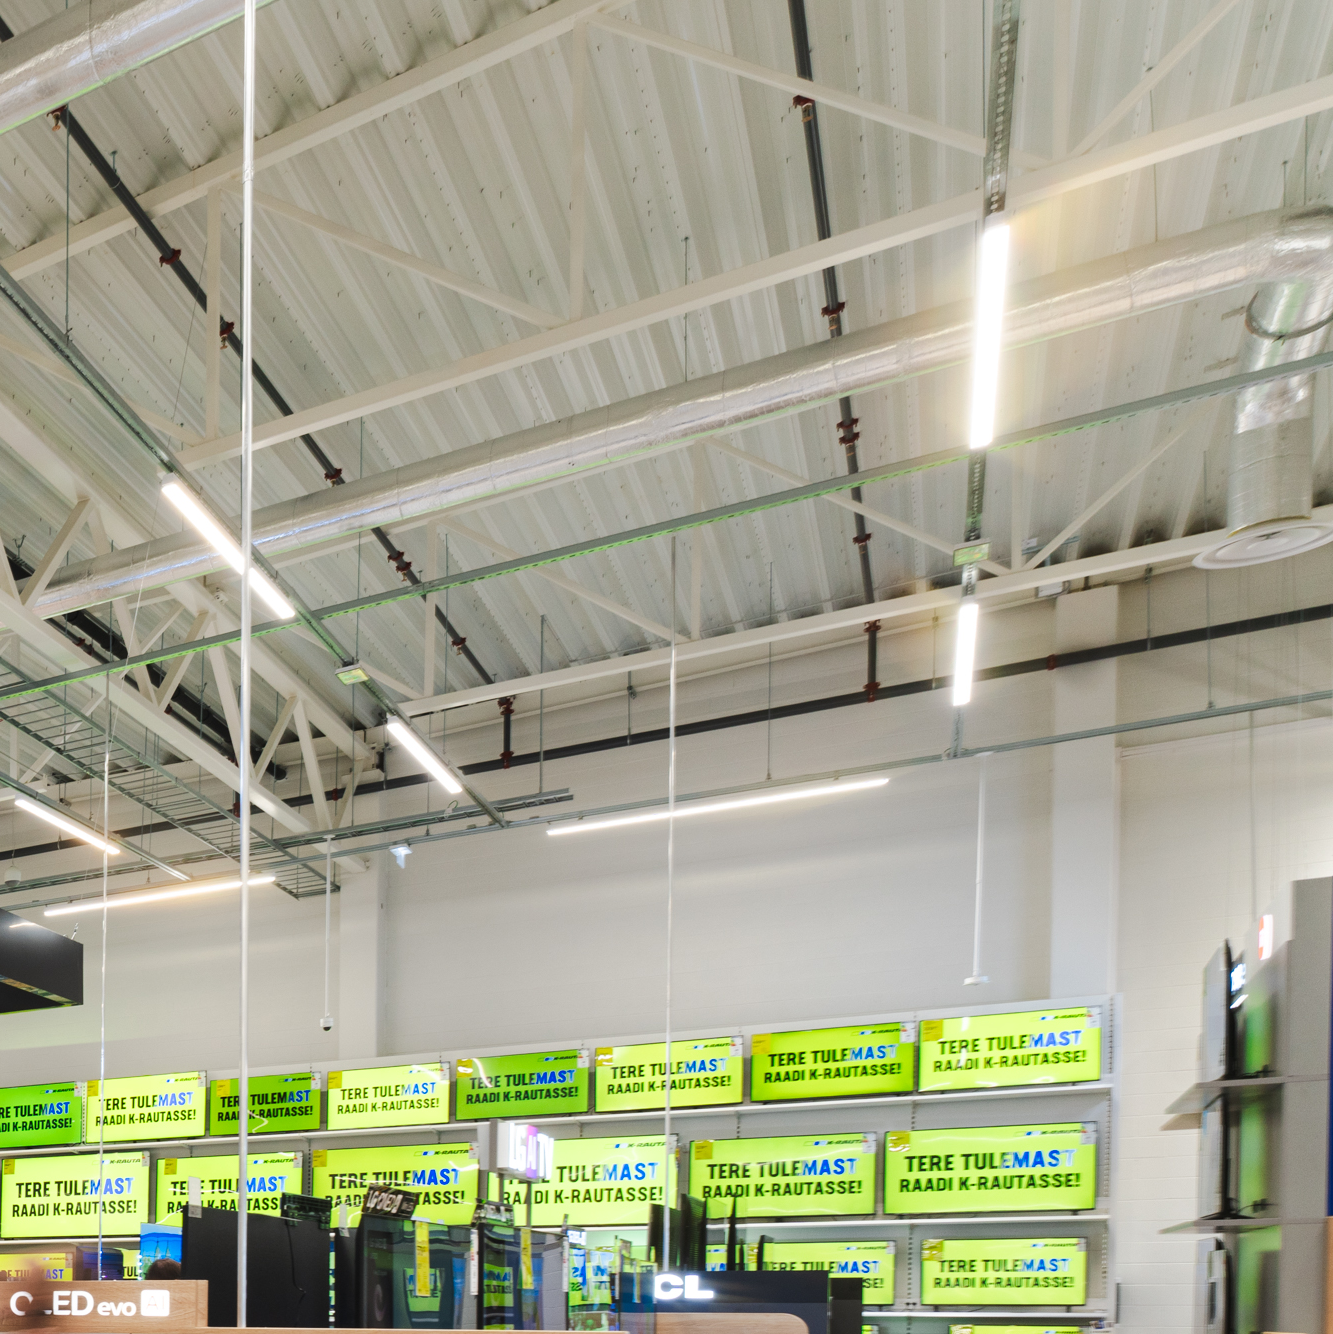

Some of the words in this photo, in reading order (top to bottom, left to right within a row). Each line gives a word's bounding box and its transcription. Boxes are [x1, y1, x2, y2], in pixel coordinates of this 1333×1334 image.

[938, 1037, 981, 1055] TERE
[986, 1030, 1083, 1051] TULEMAST
[768, 1051, 806, 1067] TERE
[811, 1044, 898, 1063] TULEMAST
[934, 1057, 978, 1072] RAADI
[984, 1050, 1087, 1068] K-RAUTASSE!
[469, 1074, 502, 1090] TERE
[505, 1070, 576, 1087] TULEMAST
[764, 1069, 806, 1084] RAADI
[810, 1062, 902, 1079] K-RAUTASSE!
[466, 1090, 500, 1105] RAADI
[503, 1085, 579, 1101] K-RAUTASSE!
[14, 1101, 70, 1118] TULEMAST
[12, 1118, 73, 1132] K-RAUTASSE!
[509, 1122, 526, 1171] LG
[537, 1133, 554, 1180] TV
[904, 1155, 955, 1172] TERE
[960, 1149, 1077, 1170] TULEMAST
[708, 1163, 751, 1179] TERE
[756, 1157, 859, 1177] TULEMAST
[15, 1182, 50, 1198] TERE
[54, 1177, 134, 1196] TULEMAST
[755, 1180, 862, 1198] K-RAUTASSE!
[900, 1177, 953, 1192] RAADI
[959, 1173, 1081, 1191] K-RAUTASSE!
[12, 1203, 49, 1217] RAADI
[53, 1200, 137, 1216] K-RAUTASSE!
[655, 1274, 714, 1299] CL
[9, 1290, 94, 1316] OED
[98, 1301, 136, 1316] evo
